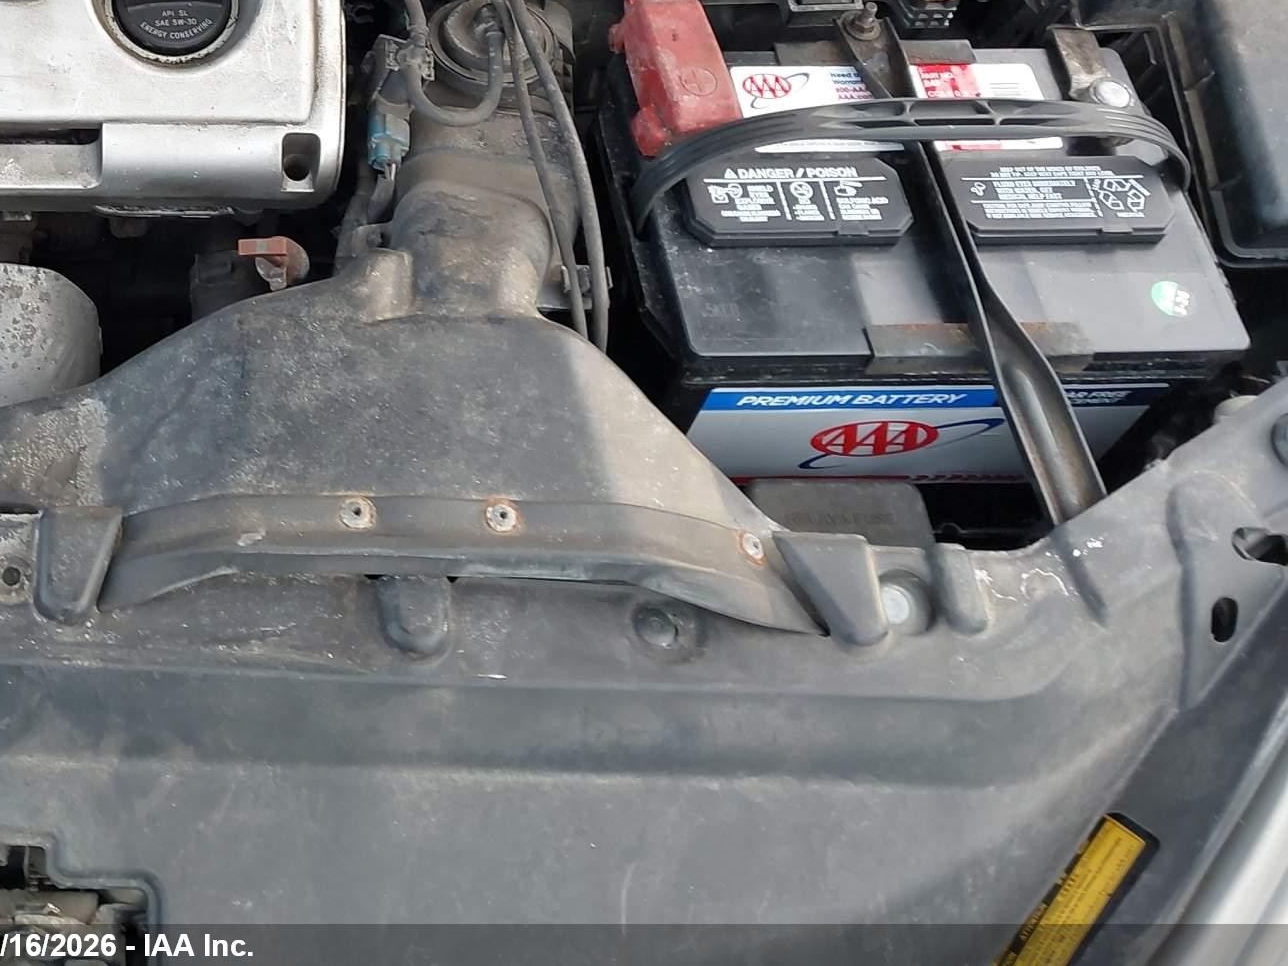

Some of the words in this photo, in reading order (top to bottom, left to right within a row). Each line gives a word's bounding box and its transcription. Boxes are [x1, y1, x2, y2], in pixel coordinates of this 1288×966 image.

[140, 21, 168, 39] ENERGY
[169, 18, 213, 40] CONSERVING
[172, 18, 198, 26] 5W-30
[743, 74, 792, 99] AAA
[737, 168, 795, 179] DANGER
[807, 166, 859, 178] POISON
[736, 394, 854, 406] PREMIUM
[854, 393, 968, 405] BATTERY
[812, 420, 938, 457] AAA
